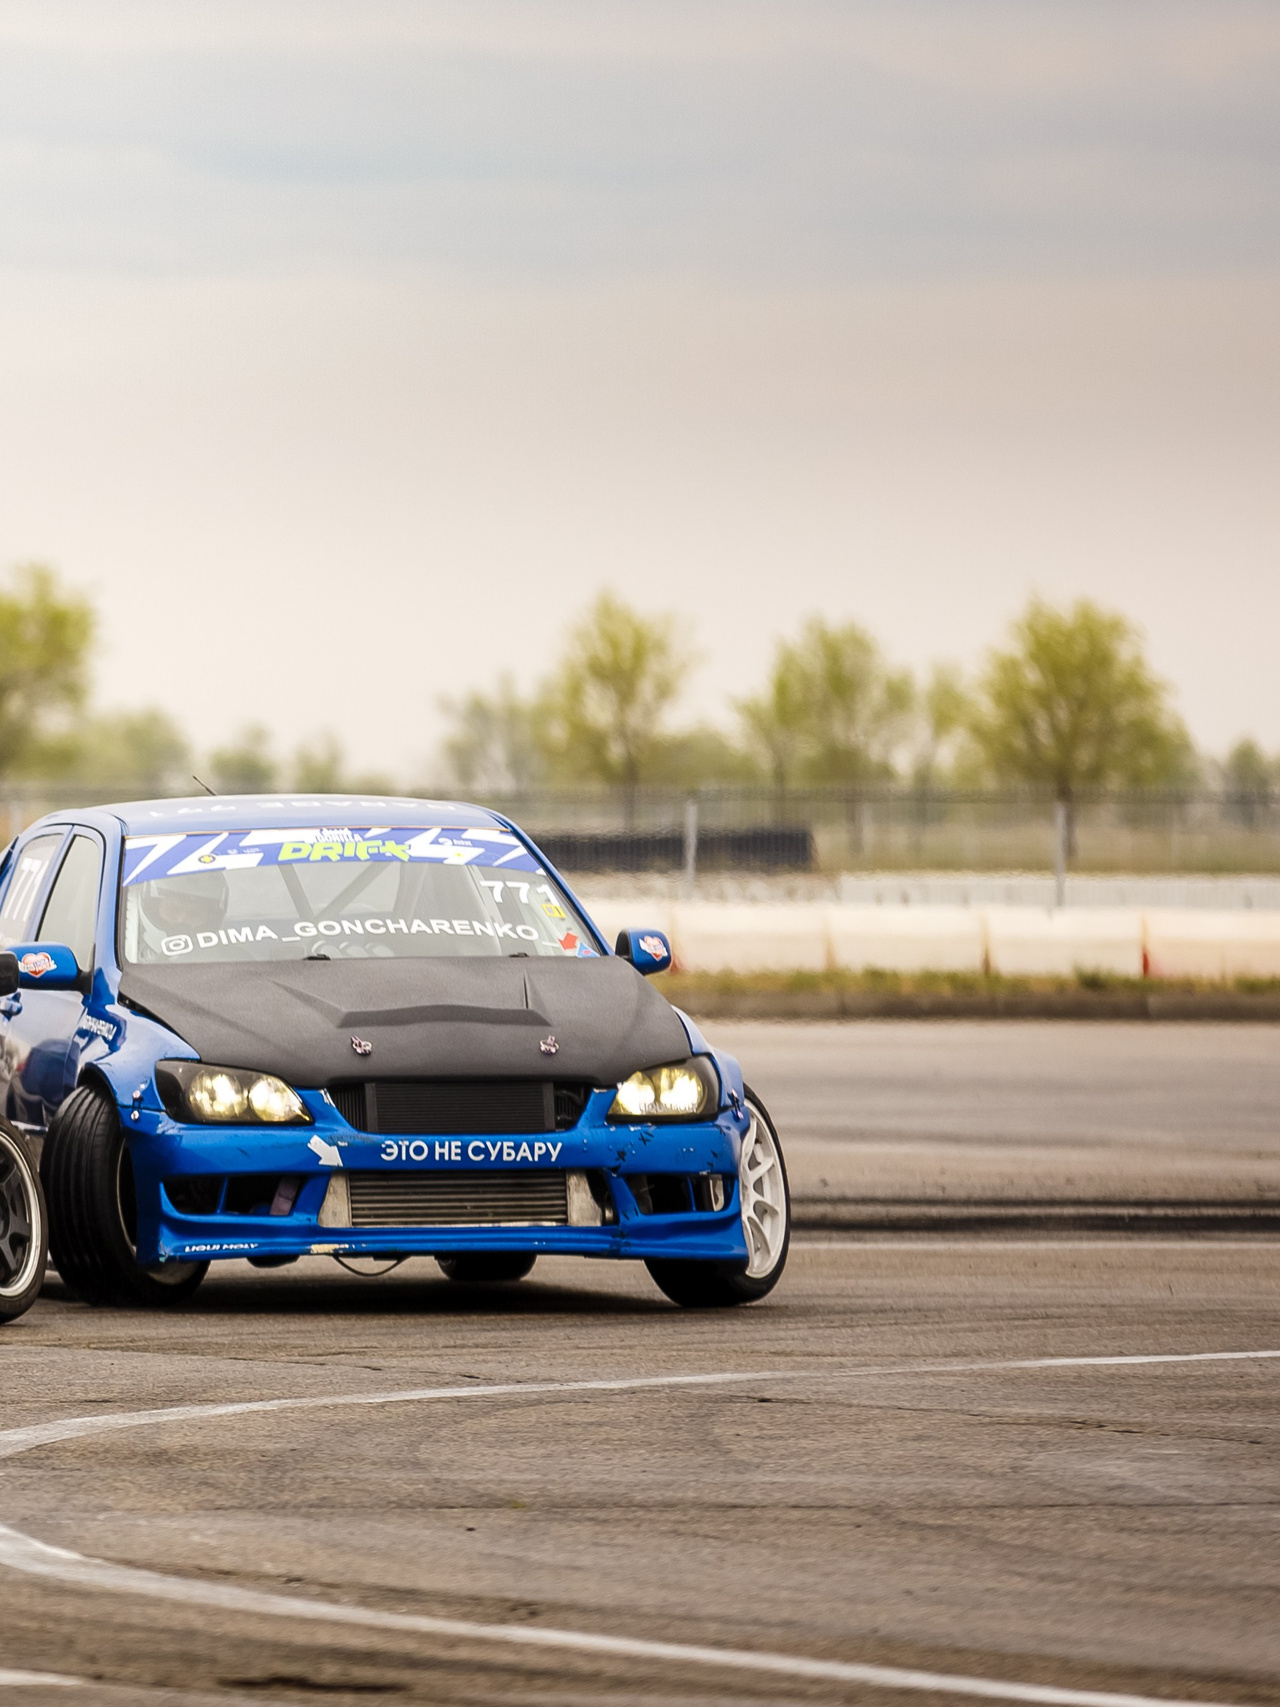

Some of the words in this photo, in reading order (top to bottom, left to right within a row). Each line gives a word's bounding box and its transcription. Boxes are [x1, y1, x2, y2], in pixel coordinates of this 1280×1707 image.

[480, 880, 560, 907] 771
[381, 1140, 429, 1162] ЭТО
[434, 1140, 462, 1162] НЕ
[467, 1140, 563, 1163] СУБАРУ
